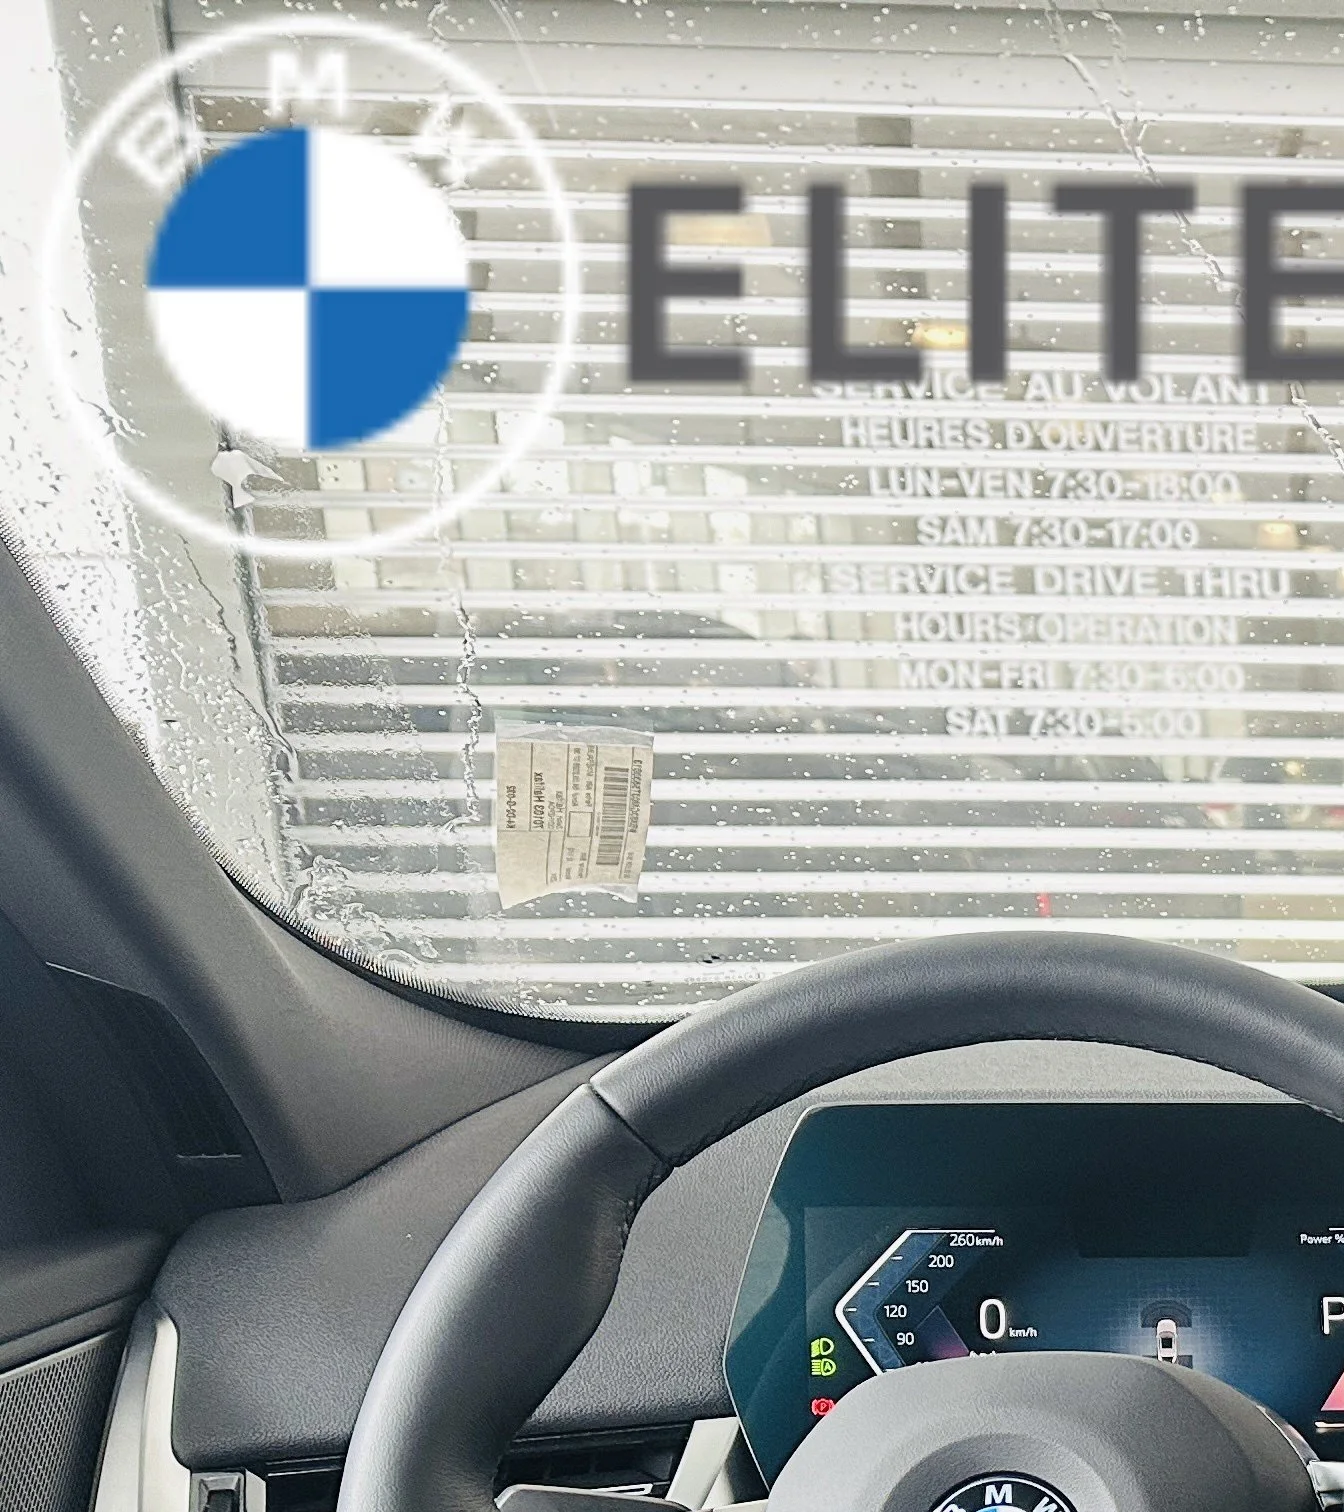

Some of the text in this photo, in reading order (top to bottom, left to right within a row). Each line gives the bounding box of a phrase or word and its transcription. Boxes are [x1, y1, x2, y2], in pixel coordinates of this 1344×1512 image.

[1024, 371, 1084, 401] AU
[840, 416, 1258, 452] HEURES D'OUVERTURE
[869, 466, 1241, 502] LUN-VEN 7:30-18:00
[916, 515, 1199, 549] SAM 7:30-17:00
[827, 561, 1291, 599] SERVICE DRIVE THRU
[895, 610, 1238, 644] HOURS OPERATION
[900, 658, 1247, 692] MON-FRI 7:30-6:00
[945, 707, 1201, 738] SAT 7:30-5:00
[1300, 1234, 1333, 1245] Power
[928, 1255, 954, 1268] 200
[906, 1279, 929, 1293] 150
[884, 1305, 907, 1318] 120
[978, 1298, 1038, 1340] 0 km/h
[896, 1332, 915, 1345] 90
